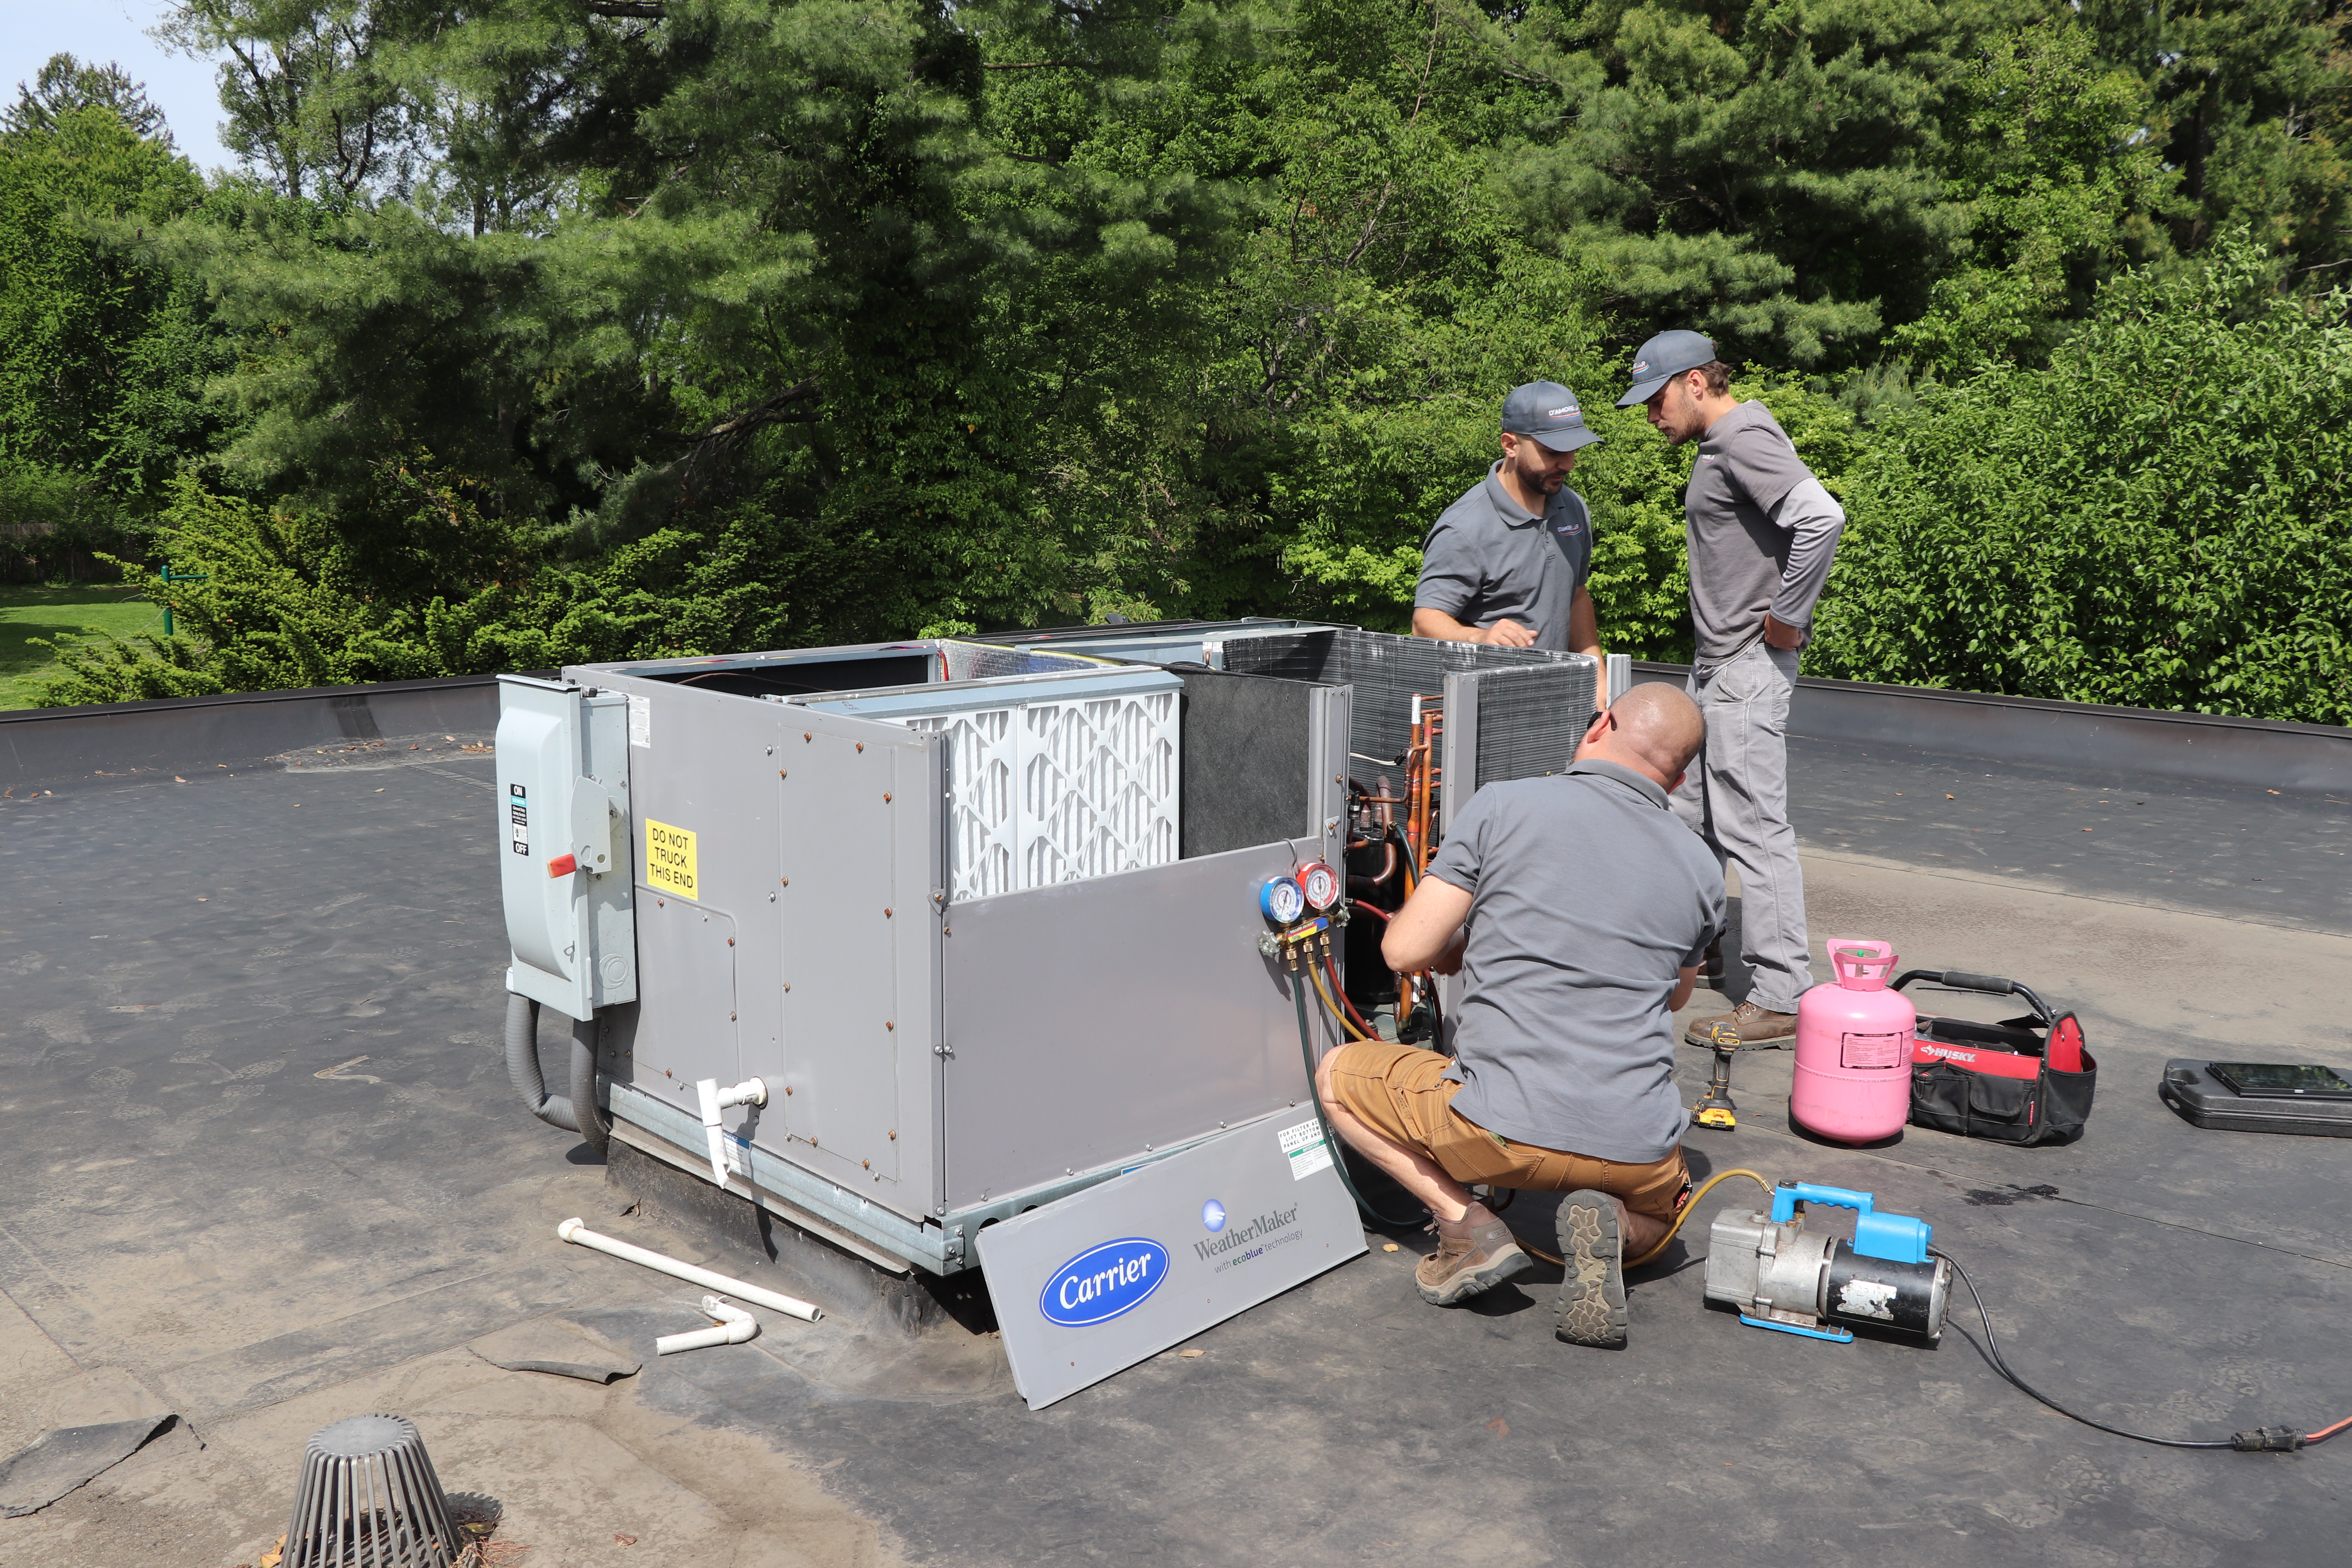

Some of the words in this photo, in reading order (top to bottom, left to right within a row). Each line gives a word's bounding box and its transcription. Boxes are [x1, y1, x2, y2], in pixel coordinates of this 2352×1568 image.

[514, 785, 523, 796] ON
[653, 828, 666, 843] DO
[669, 832, 688, 850] NOT
[515, 843, 527, 854] OFF
[655, 846, 688, 869] TRUCK
[650, 863, 671, 881] THIS
[673, 871, 693, 888] END
[1302, 921, 1315, 929] JACKET
[1934, 1047, 1976, 1062] HUSKY
[1292, 1124, 1309, 1133] FILTER
[1299, 1125, 1319, 1137] BOTTOM
[723, 1131, 738, 1143] NOTICE
[1283, 1140, 1300, 1149] PANEL
[1302, 1142, 1320, 1152] IMPORTANT
[1214, 1260, 1232, 1273] with
[1264, 1229, 1303, 1252] technology
[1060, 1253, 1151, 1309] Carrier
